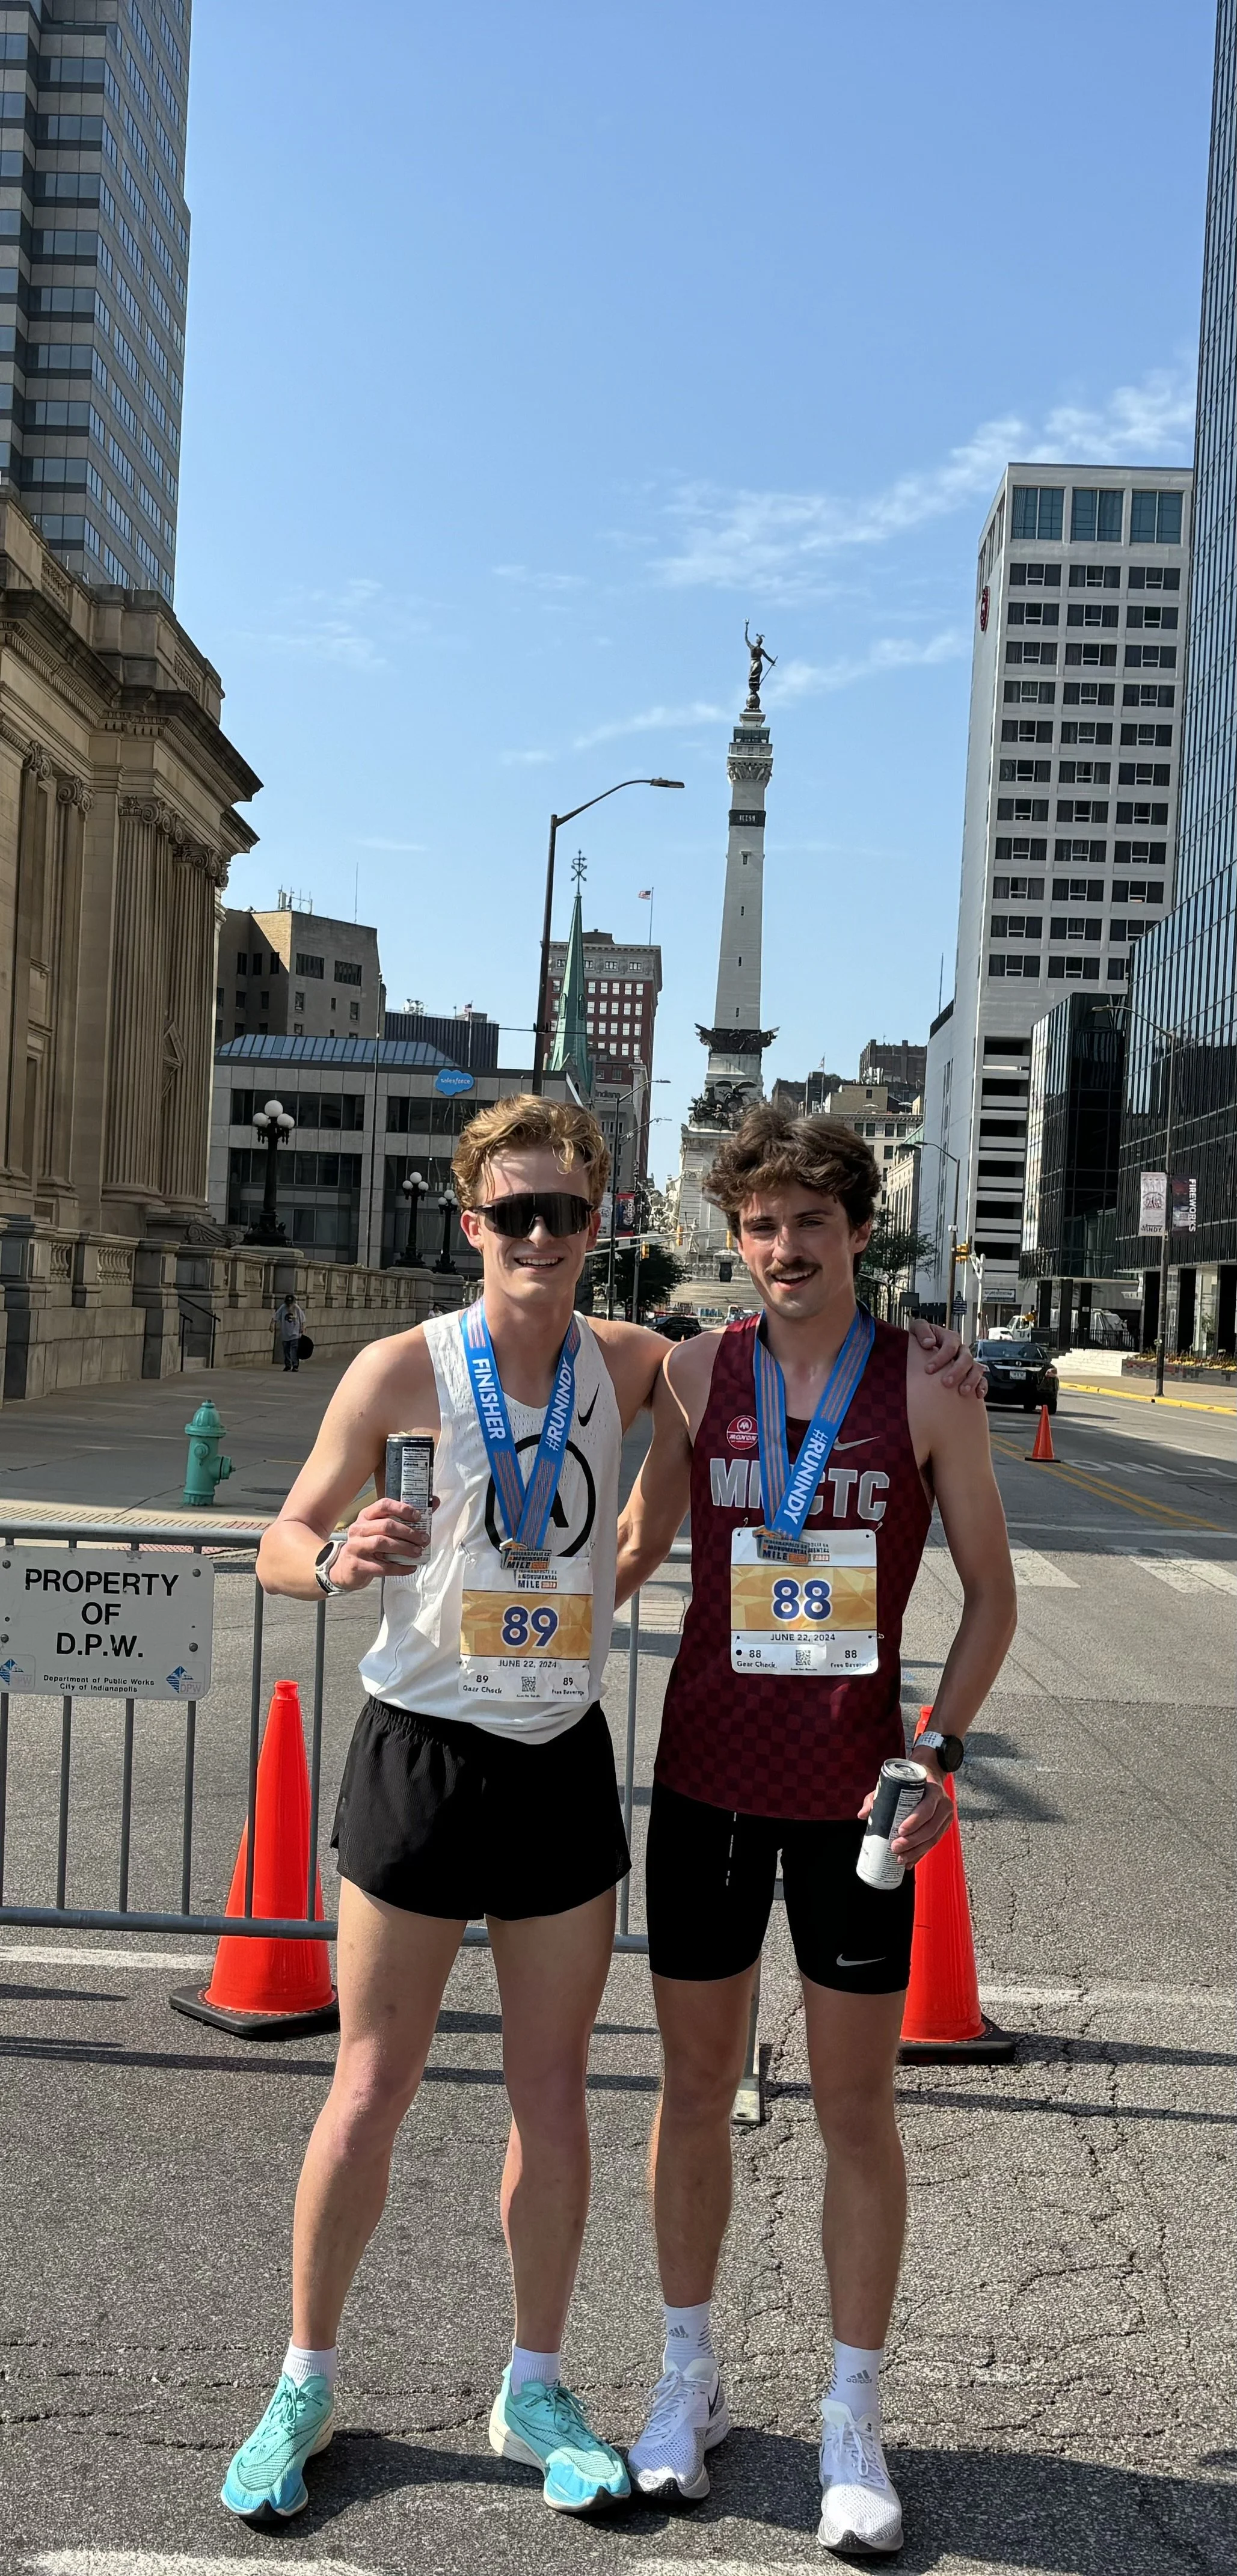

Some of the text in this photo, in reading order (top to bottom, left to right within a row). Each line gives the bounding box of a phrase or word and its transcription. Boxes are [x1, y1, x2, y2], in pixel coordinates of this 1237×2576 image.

[1188, 1179, 1197, 1232] FIREWORKS
[472, 1358, 506, 1440] FINISHER
[545, 1356, 572, 1451] #RUNINDY
[784, 1428, 829, 1525] #RUNINDY
[763, 1550, 788, 1560] MILE
[25, 1568, 179, 1596] PROPERTY
[518, 1580, 539, 1588] MILE
[771, 1577, 833, 1622] 88
[81, 1601, 121, 1625] OF
[500, 1604, 559, 1648] 89
[797, 1634, 811, 1642] 22,
[57, 1632, 144, 1658] D.P.W.
[749, 1650, 761, 1658] 88
[844, 1650, 858, 1658] 88
[43, 1675, 88, 1683] Department
[476, 1675, 489, 1683] 89
[563, 1677, 573, 1685] 89
[60, 1683, 75, 1691] City
[91, 1684, 138, 1693] Indianapolis
[180, 1683, 201, 1693] DPW
